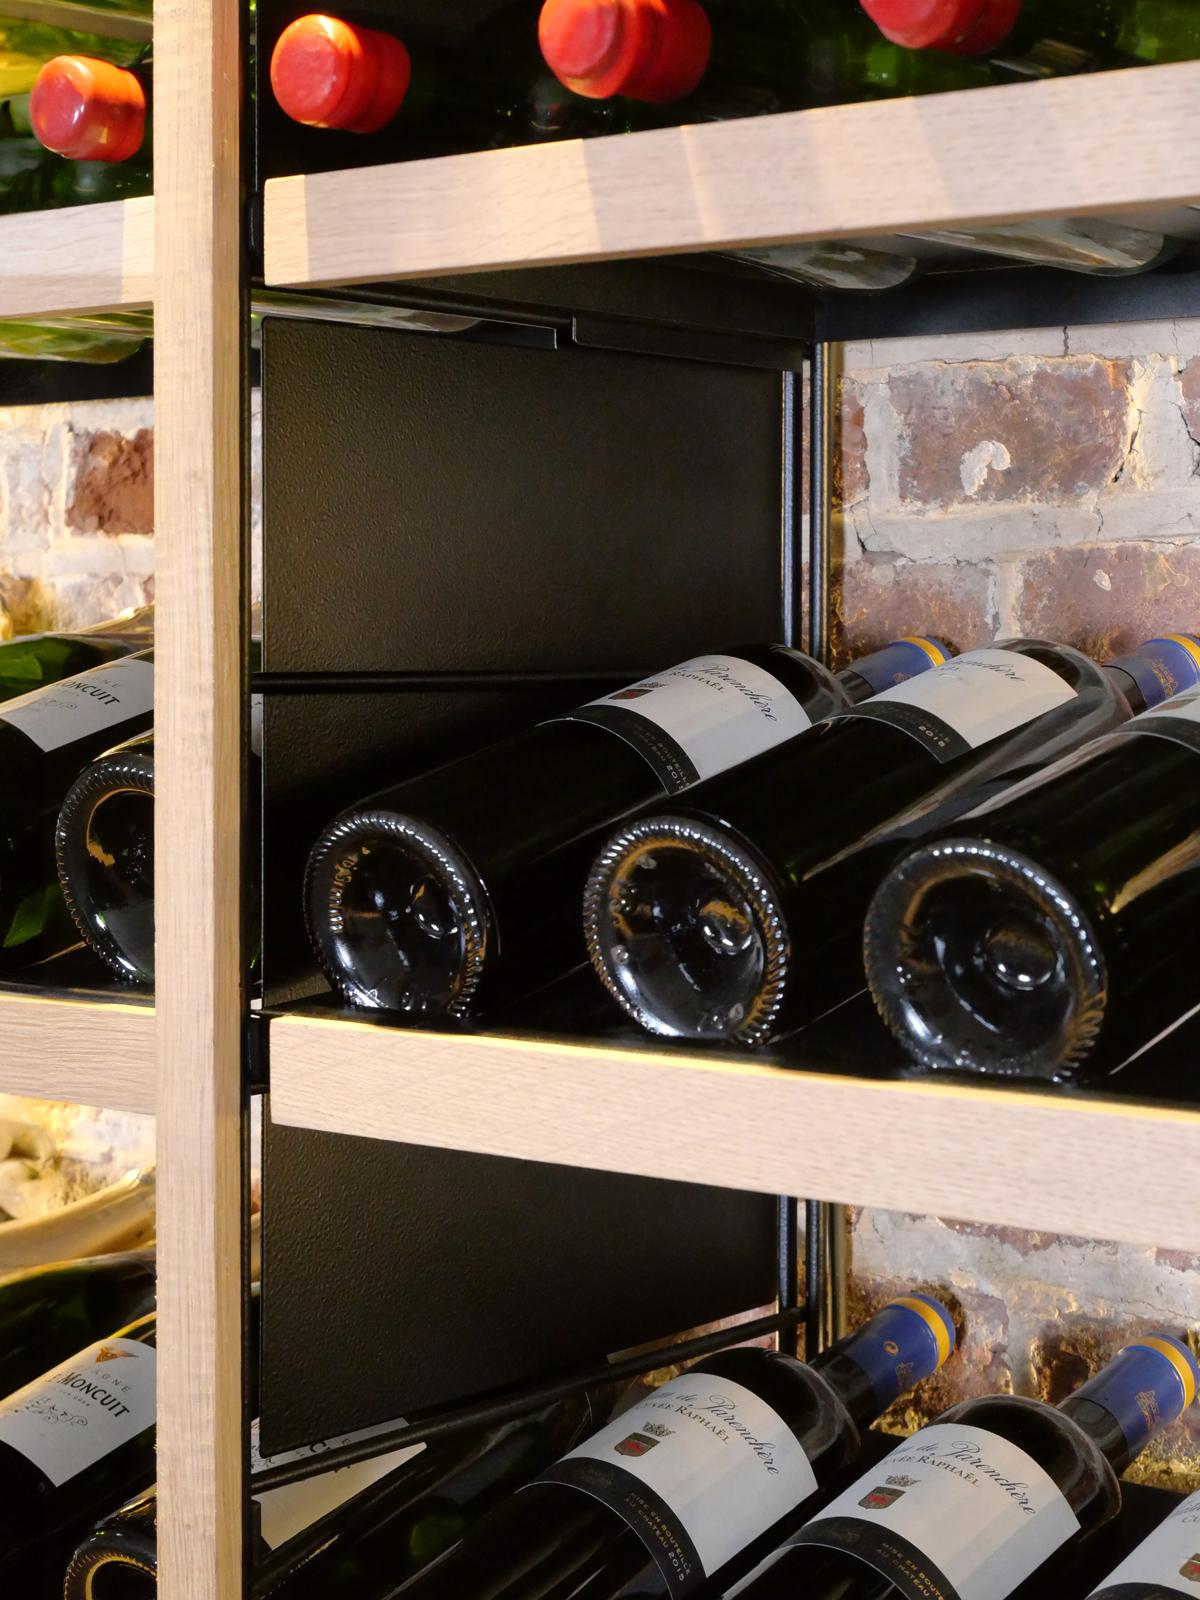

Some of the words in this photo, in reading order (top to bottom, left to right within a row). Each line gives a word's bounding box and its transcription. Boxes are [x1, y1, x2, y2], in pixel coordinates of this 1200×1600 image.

[669, 671, 725, 694] RAPHAËL
[682, 661, 778, 723] Parenchère
[55, 1371, 131, 1418] MONCUIT
[675, 1405, 730, 1446] RAPHAËL
[688, 1394, 780, 1477] Parenchère
[916, 1442, 939, 1452] de
[930, 1440, 1036, 1517] Parenchère
[917, 1455, 980, 1488] RAPHAËL
[624, 1497, 637, 1508] AU
[637, 1509, 669, 1548] CHATEAU
[668, 1551, 685, 1581] 2015
[631, 1492, 650, 1510] MISE
[650, 1510, 662, 1522] EN
[661, 1523, 692, 1576] BOUTEILLE
[881, 1542, 905, 1559] MISE
[905, 1559, 918, 1571] EN
[876, 1548, 890, 1558] AU
[892, 1559, 930, 1597] CHATEAU
